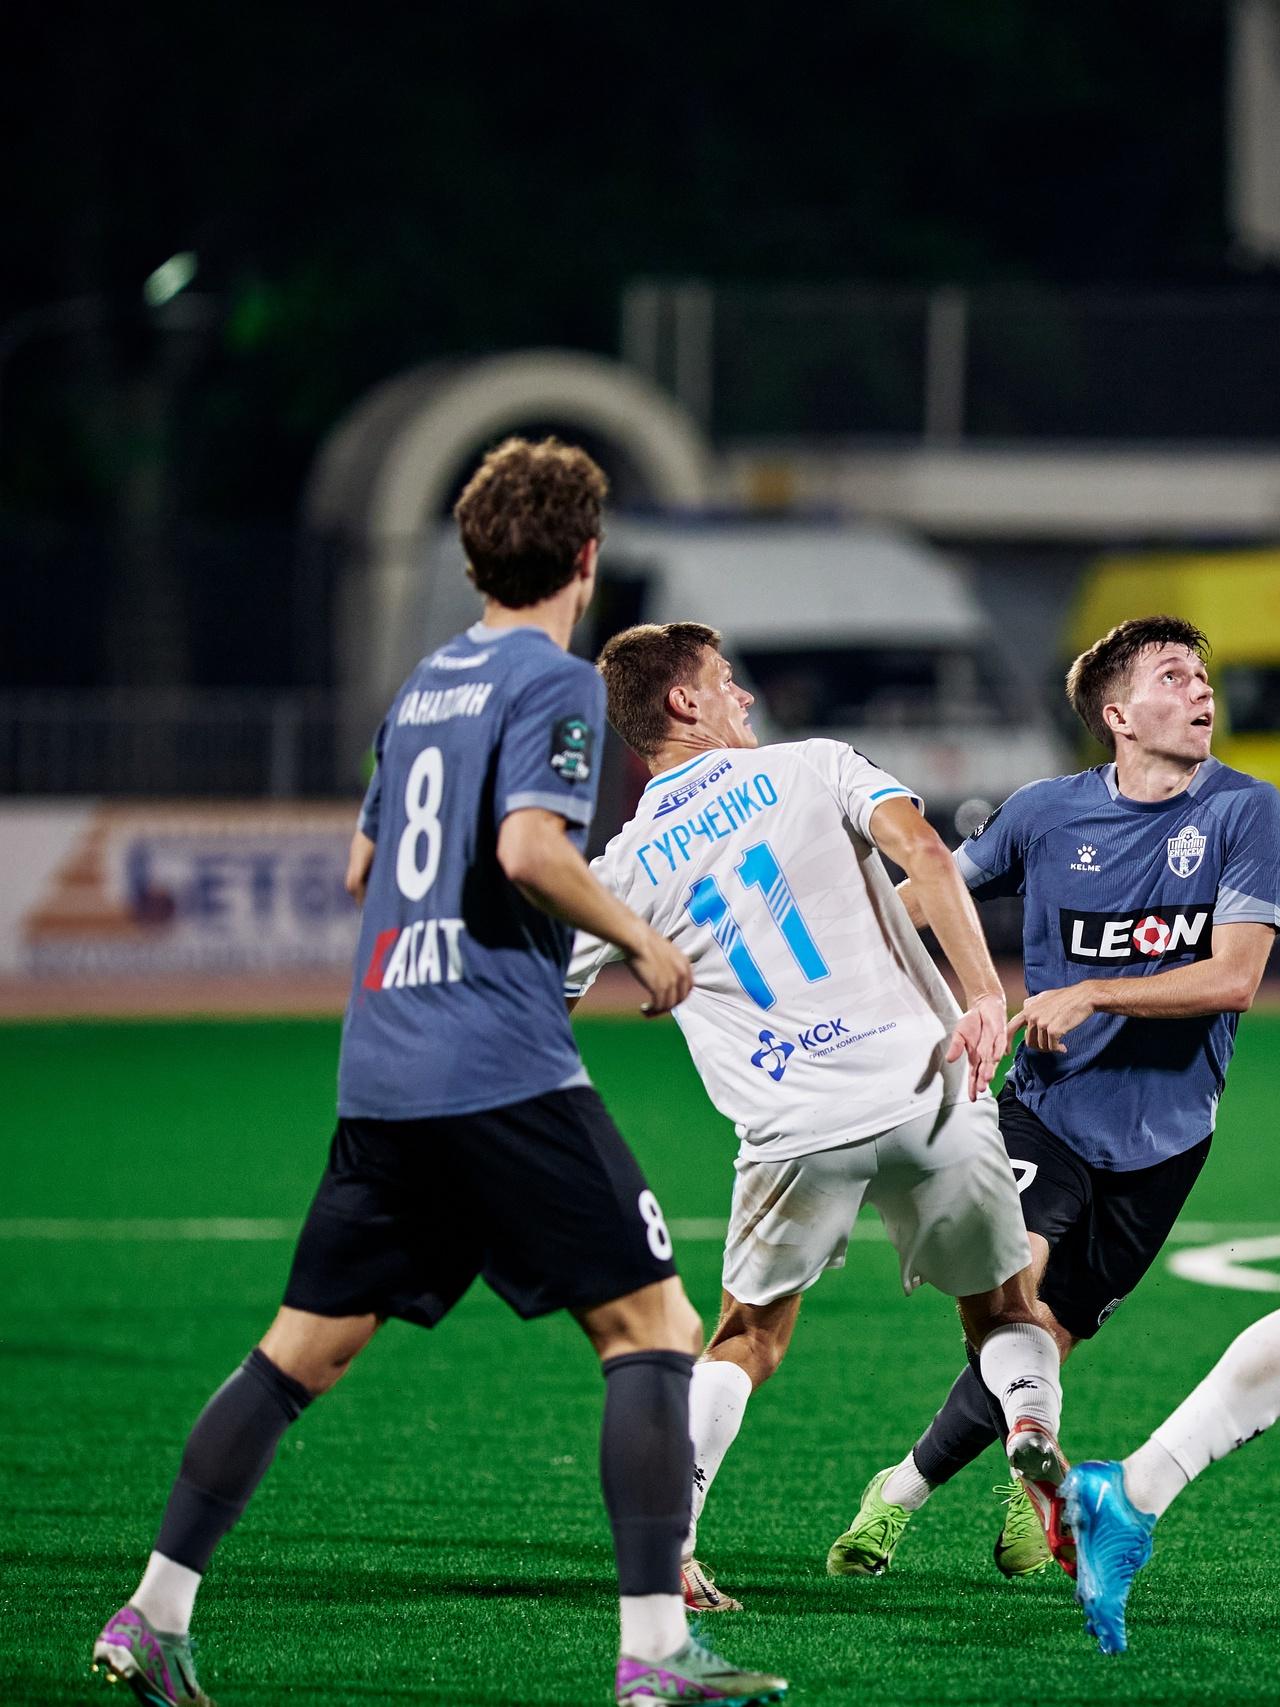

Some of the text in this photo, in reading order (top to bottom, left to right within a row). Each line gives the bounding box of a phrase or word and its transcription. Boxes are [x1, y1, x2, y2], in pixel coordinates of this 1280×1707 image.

[671, 762, 733, 807] БЕТОН
[395, 746, 444, 902] 8
[636, 773, 778, 886] ГУРЧЕНКО
[1070, 863, 1101, 872] KELME
[684, 840, 831, 1012] 11
[1071, 913, 1208, 957] LEON
[798, 1018, 850, 1050] КСК
[638, 1188, 674, 1261] 8
